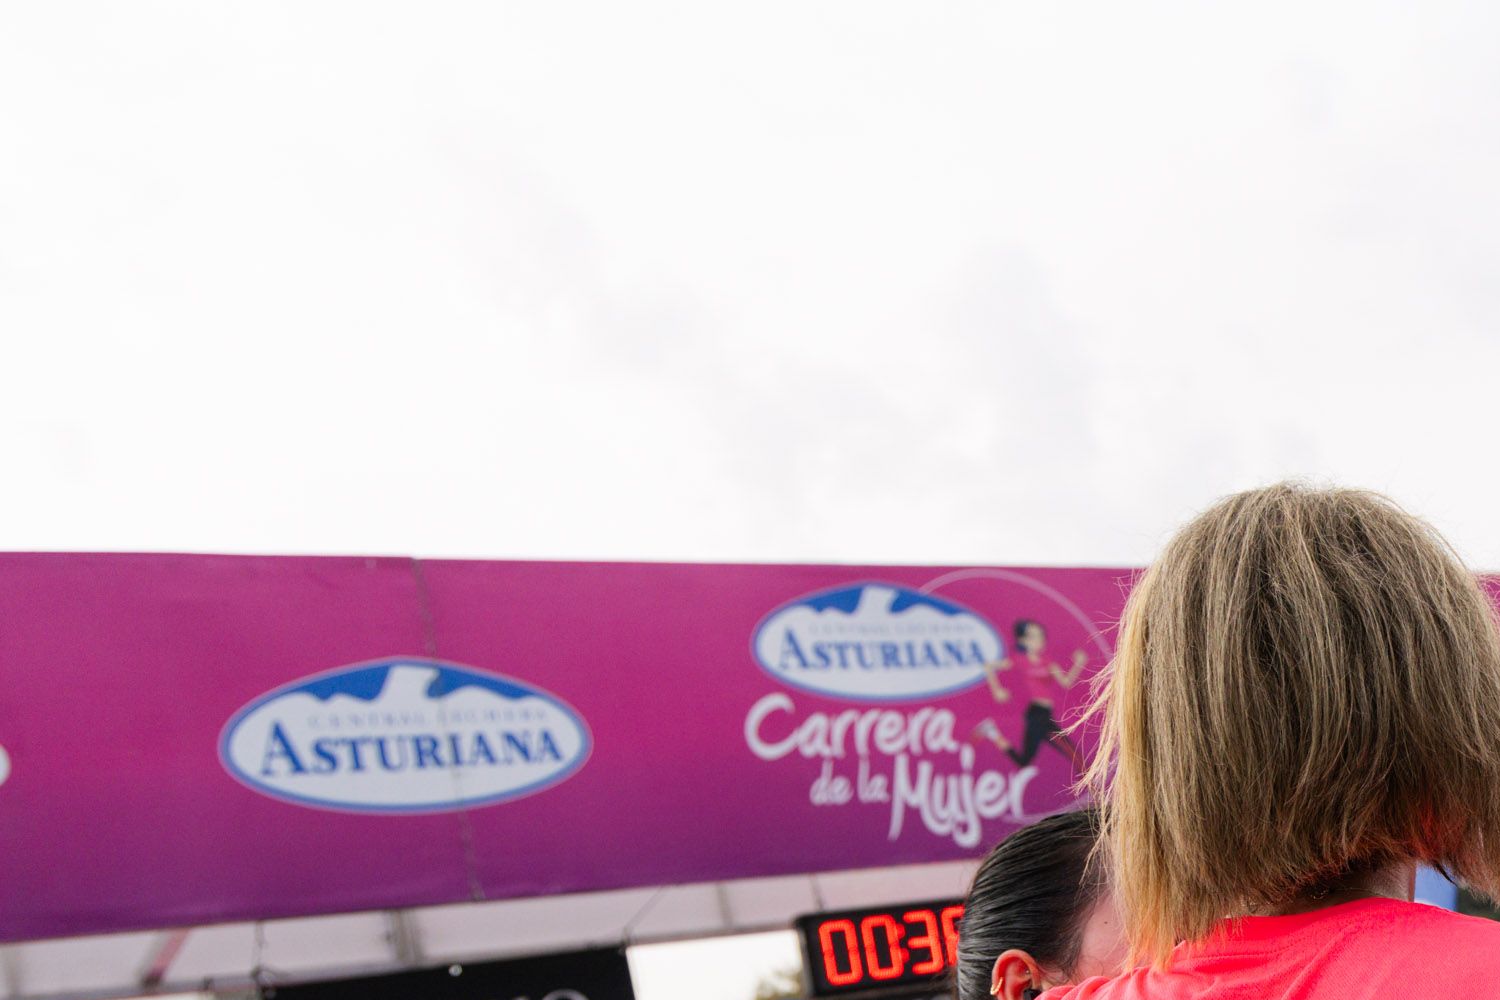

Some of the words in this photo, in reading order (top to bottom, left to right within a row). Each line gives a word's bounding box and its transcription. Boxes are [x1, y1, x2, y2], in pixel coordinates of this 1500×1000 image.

[779, 627, 987, 672] ASTURIANA
[259, 719, 564, 778] ASTURIANA
[744, 693, 961, 760] Carrera
[809, 758, 853, 806] de
[857, 755, 891, 805] la
[888, 746, 1039, 848] Mujer
